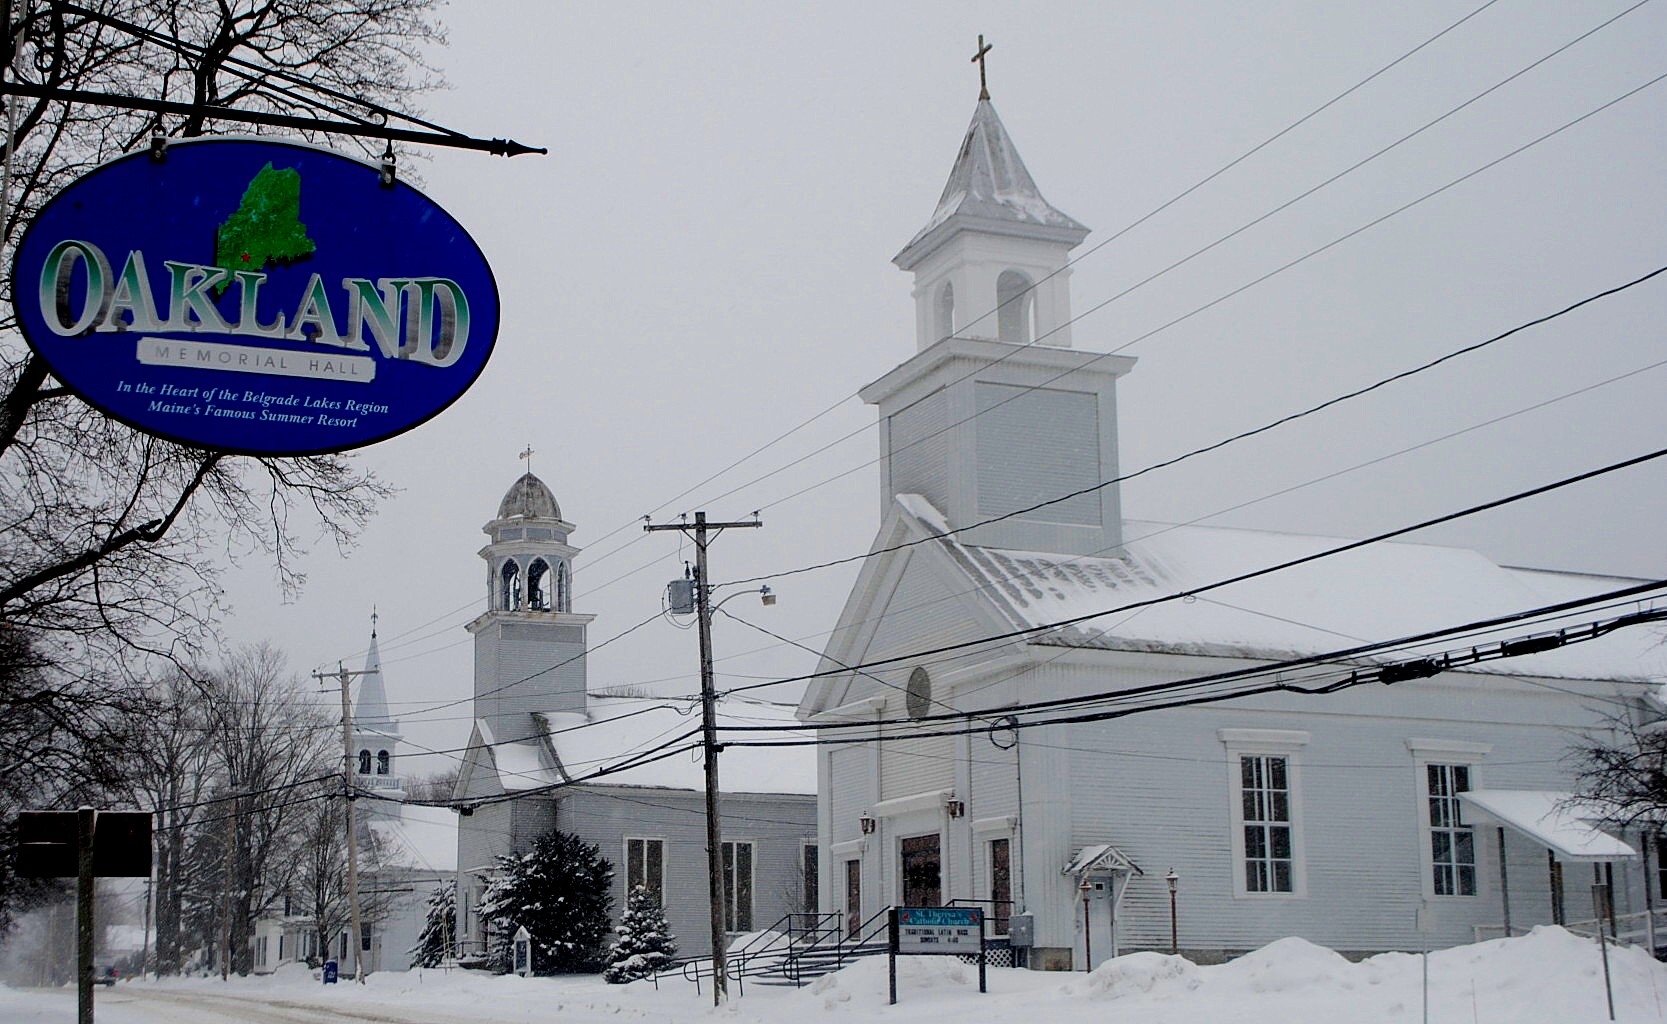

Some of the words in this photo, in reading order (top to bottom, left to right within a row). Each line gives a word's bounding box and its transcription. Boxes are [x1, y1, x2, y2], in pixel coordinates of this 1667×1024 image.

[39, 239, 471, 368] OAKLAND
[155, 345, 288, 369] MEMORIAL
[309, 359, 359, 375] HALL
[116, 380, 132, 393] In
[135, 382, 156, 394] the
[160, 384, 199, 398] Heart
[202, 388, 218, 403] of
[218, 389, 239, 401] the
[242, 391, 300, 408] Belgrade
[303, 396, 342, 410] Lakes
[345, 399, 389, 416] Region
[147, 400, 201, 415] Maine's
[204, 404, 256, 419] Famous
[259, 409, 314, 424] Summer
[317, 414, 358, 428] Resort
[941, 917, 969, 925] Church
